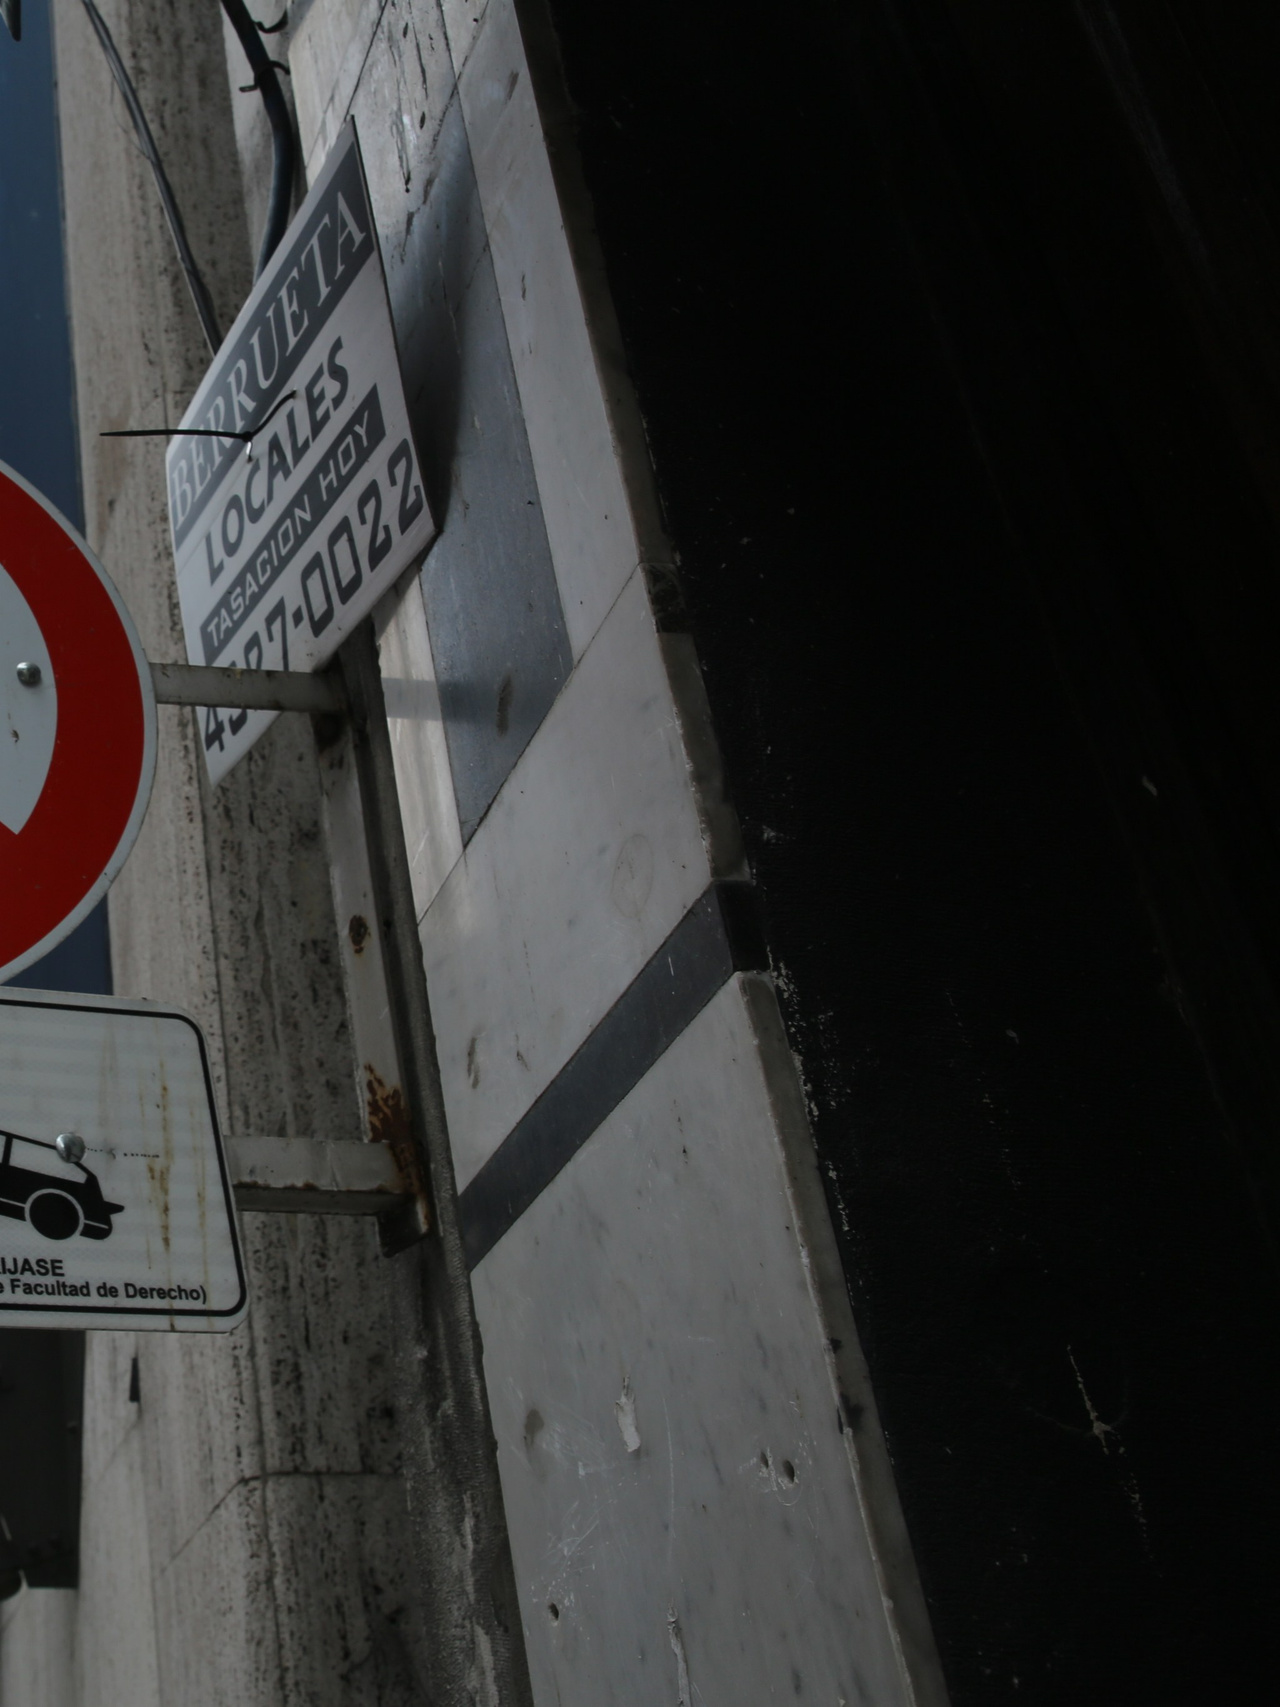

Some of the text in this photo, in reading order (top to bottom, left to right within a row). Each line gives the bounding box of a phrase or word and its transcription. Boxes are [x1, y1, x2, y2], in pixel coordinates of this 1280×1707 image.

[170, 191, 367, 529] BERRUETA
[205, 335, 350, 588] LOCALES
[206, 410, 371, 649] TASACION HOY
[10, 1278, 91, 1298] Facultad
[96, 1282, 119, 1299] de
[124, 1283, 208, 1304] Derecho)
